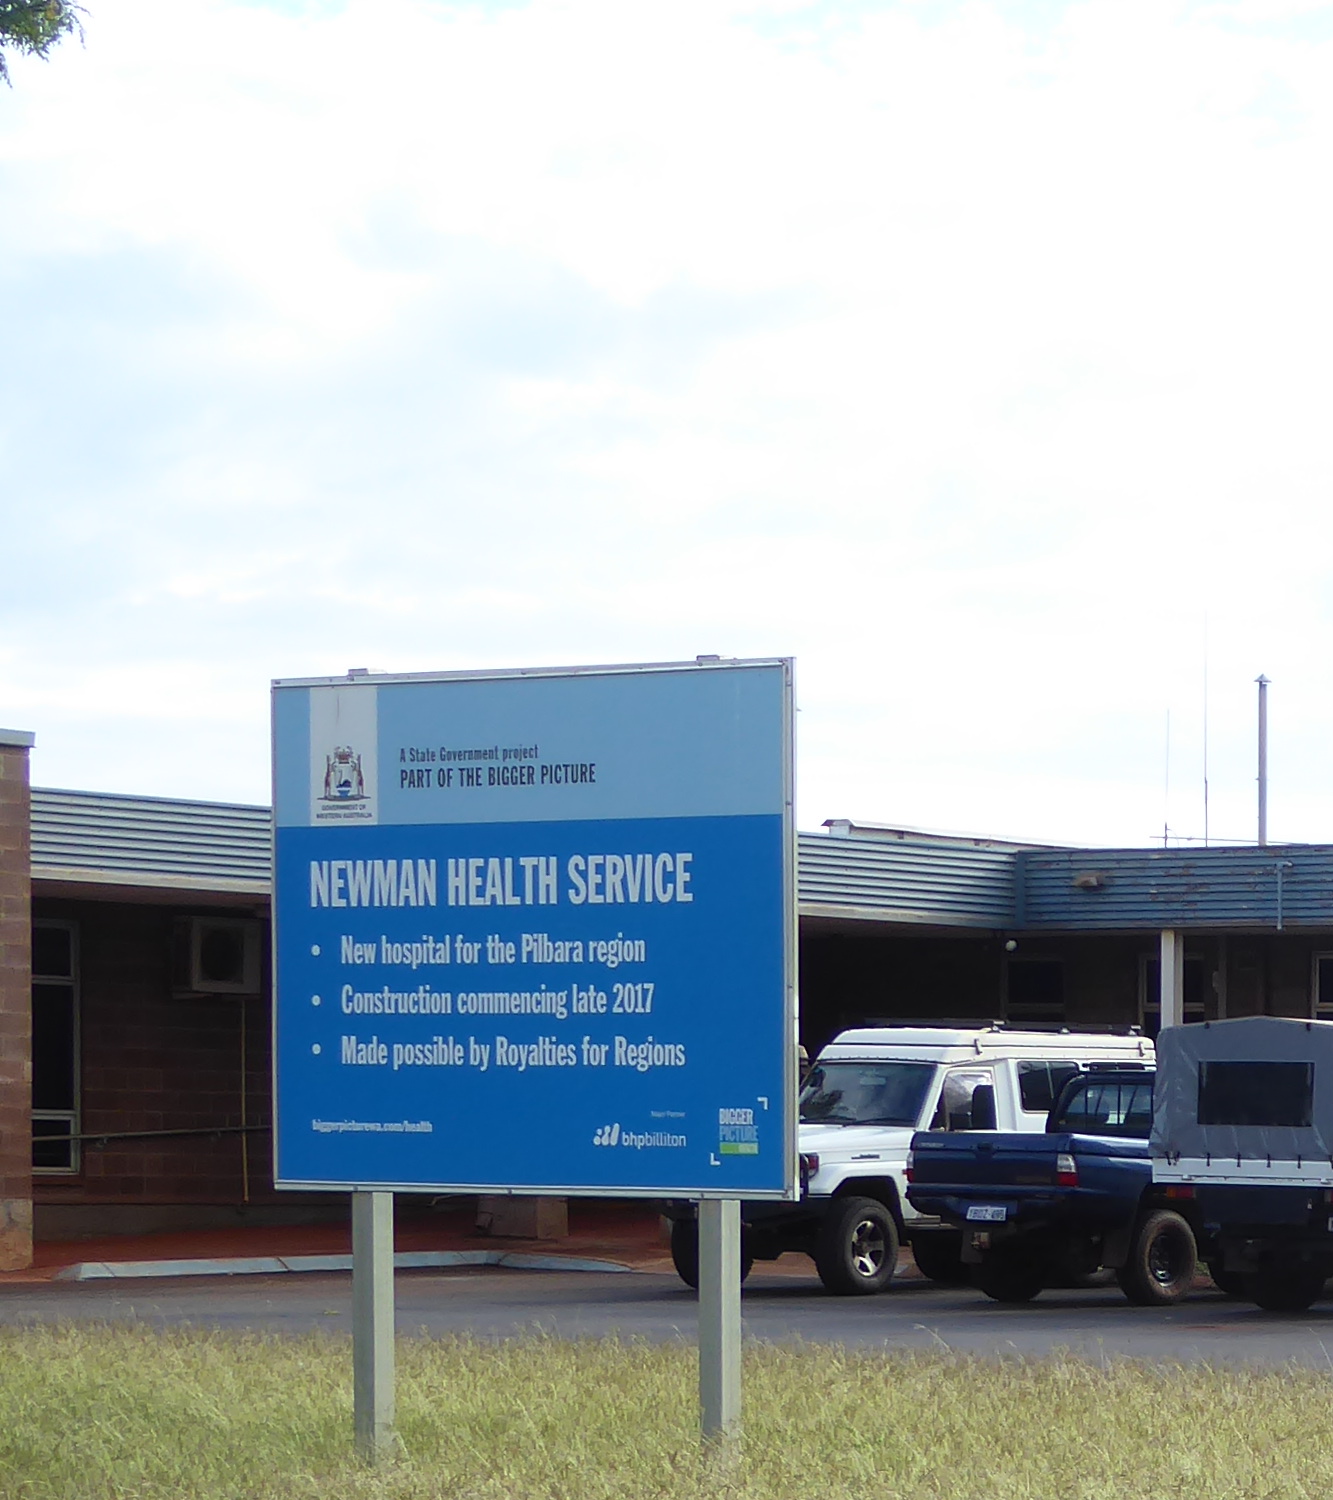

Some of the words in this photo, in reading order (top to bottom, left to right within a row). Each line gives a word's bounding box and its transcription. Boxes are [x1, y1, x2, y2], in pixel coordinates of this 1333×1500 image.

[399, 748, 407, 763] A
[409, 747, 436, 763] State
[439, 745, 499, 762] Government
[502, 744, 539, 762] project
[400, 767, 432, 789] PART
[437, 767, 454, 788] OF
[458, 766, 483, 787] THE
[488, 765, 536, 786] BIGGER
[540, 763, 597, 785] PICTURE
[310, 859, 437, 908] NEWMAN
[447, 856, 558, 906] HEALTH
[567, 852, 694, 904] SERVICE
[341, 935, 376, 964] New
[381, 935, 451, 969] hospital
[455, 934, 482, 964] for
[486, 935, 516, 963] the
[521, 933, 584, 963] Pilbara
[588, 932, 646, 968] region
[341, 984, 452, 1014] Construction
[457, 984, 568, 1019] commencing
[572, 984, 607, 1014] late
[612, 983, 655, 1013] 2017
[341, 1035, 388, 1065] Made
[393, 1035, 464, 1070] possible
[469, 1036, 491, 1071] by
[495, 1035, 577, 1071] Royalties
[581, 1036, 609, 1066] for
[614, 1036, 686, 1071] Regions
[719, 1108, 754, 1125] BIGGER
[622, 1131, 687, 1150] bhpbilliton
[719, 1125, 759, 1142] PICTURE
